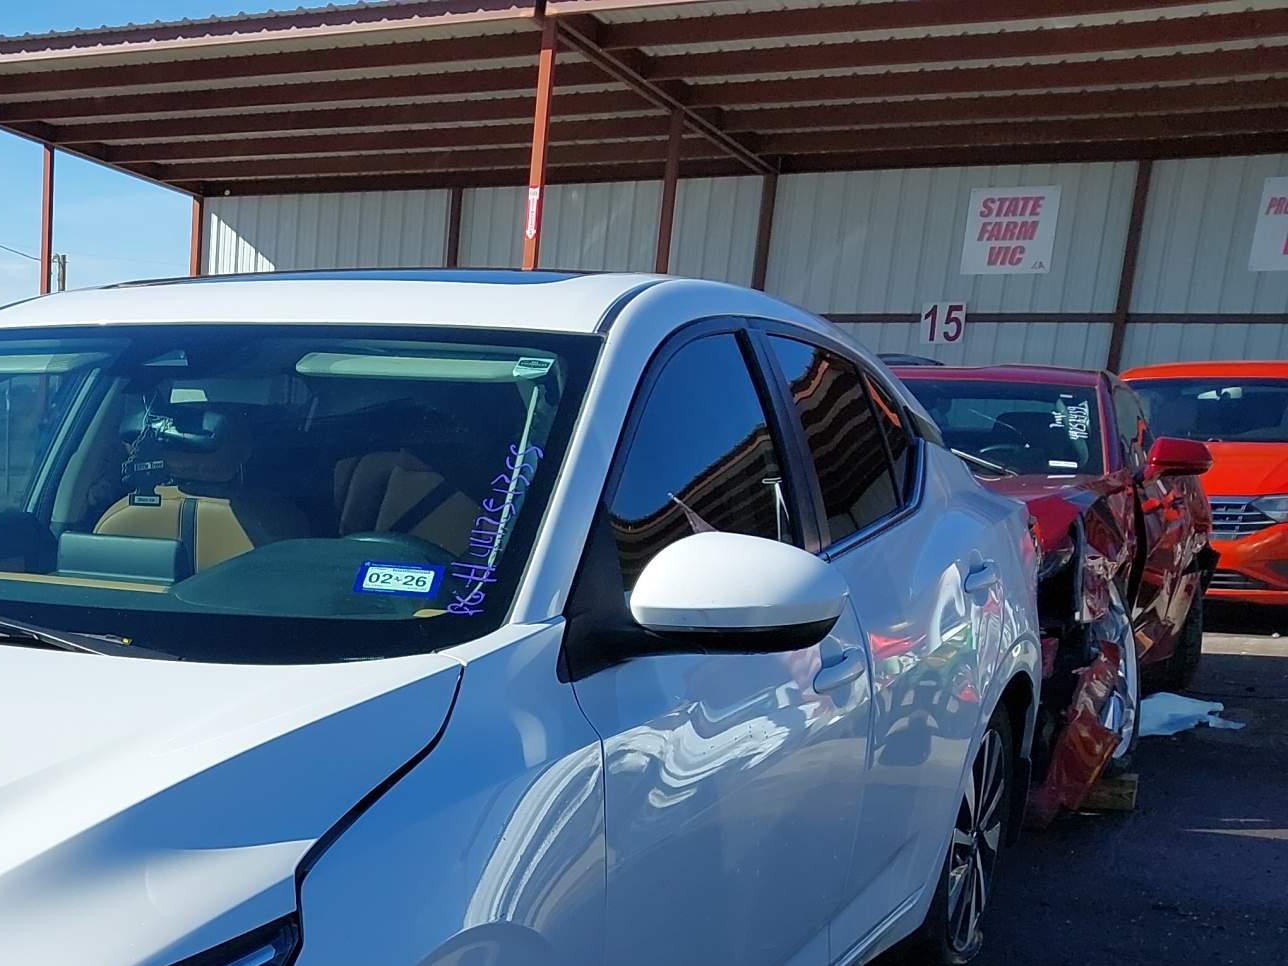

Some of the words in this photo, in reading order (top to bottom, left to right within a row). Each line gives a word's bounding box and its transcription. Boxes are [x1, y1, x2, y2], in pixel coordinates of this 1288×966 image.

[979, 196, 1046, 218] STATE
[976, 220, 1040, 242] FARM
[987, 245, 1026, 266] VIC
[924, 304, 963, 342] 15
[368, 572, 393, 585] 02
[402, 575, 428, 587] 26
